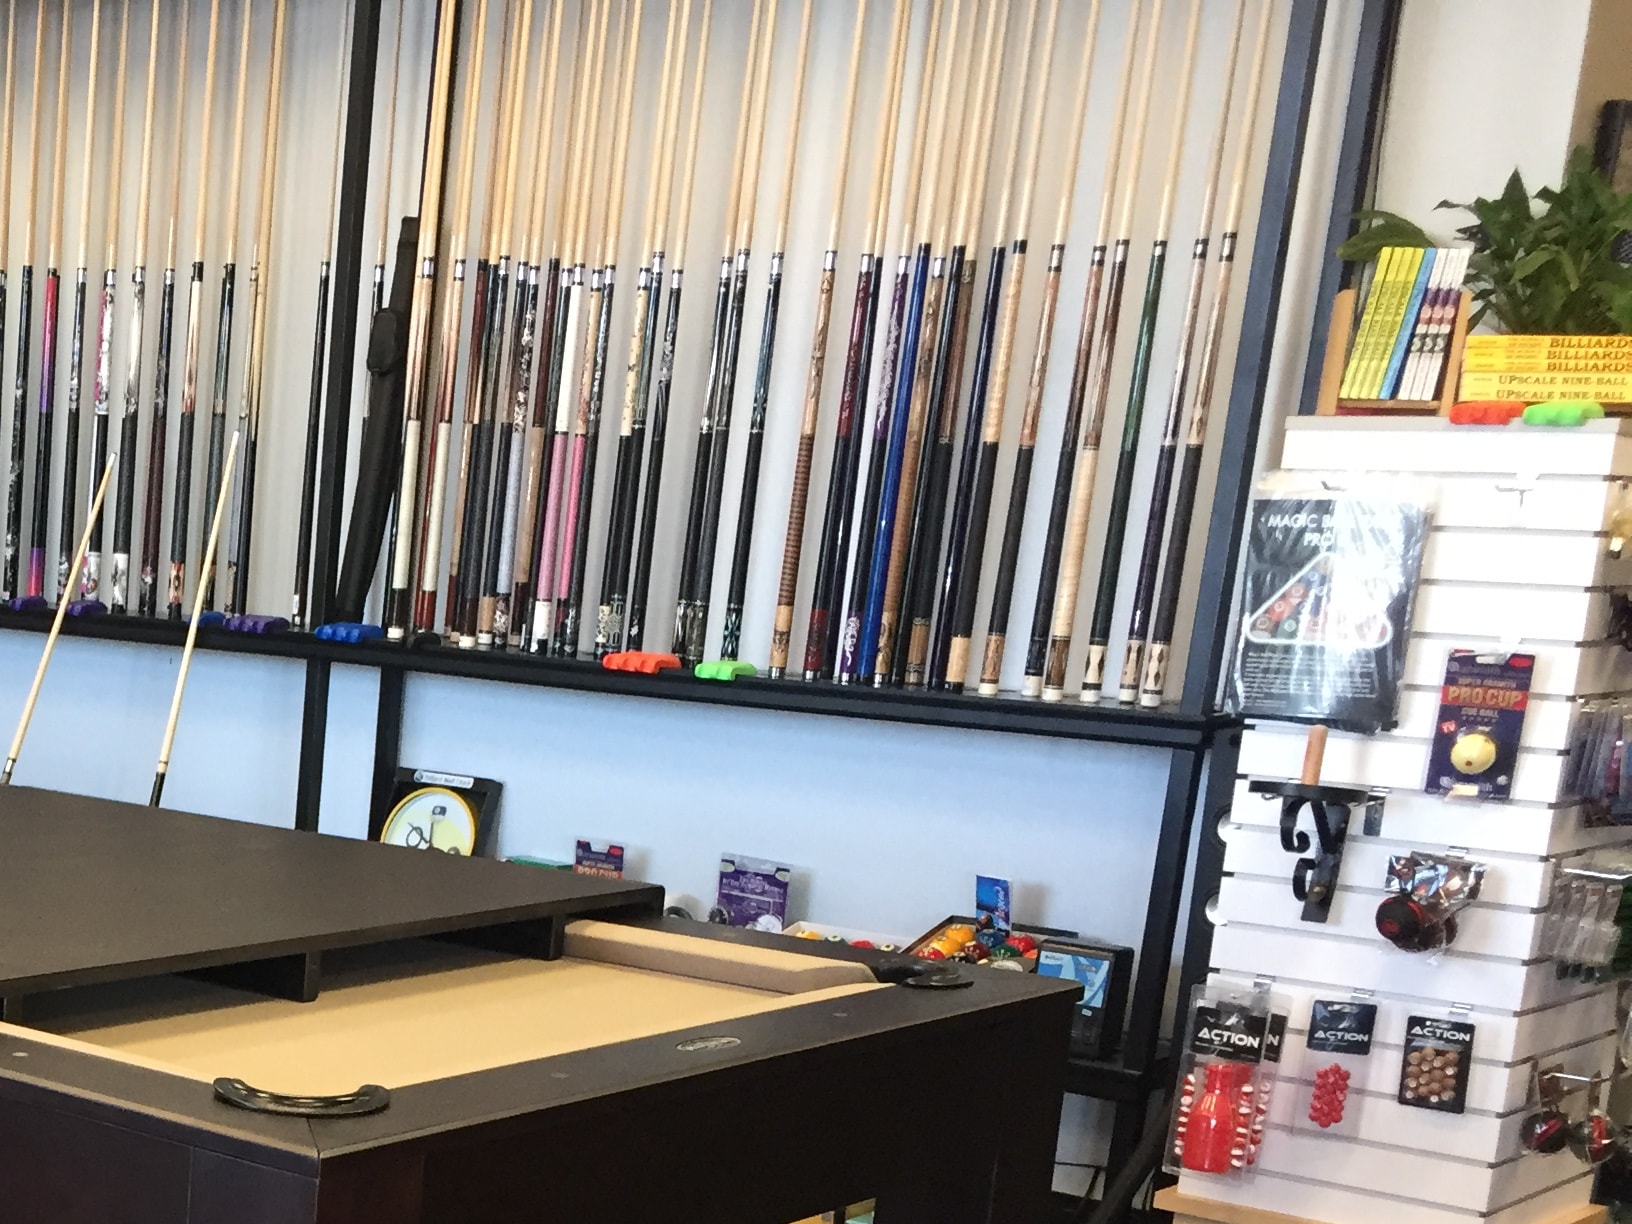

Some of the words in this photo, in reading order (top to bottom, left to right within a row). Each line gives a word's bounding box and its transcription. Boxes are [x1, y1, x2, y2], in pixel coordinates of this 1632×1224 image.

[1499, 375, 1558, 385] UPSCALE
[1496, 389, 1555, 400] UPSCALE
[1268, 514, 1318, 528] MAGIC
[1448, 686, 1484, 705] PRO
[1486, 689, 1524, 707] CUP
[1197, 1027, 1261, 1049] ACTION
[1314, 1029, 1369, 1042] ACTION
[1410, 1025, 1471, 1042] ACTION
